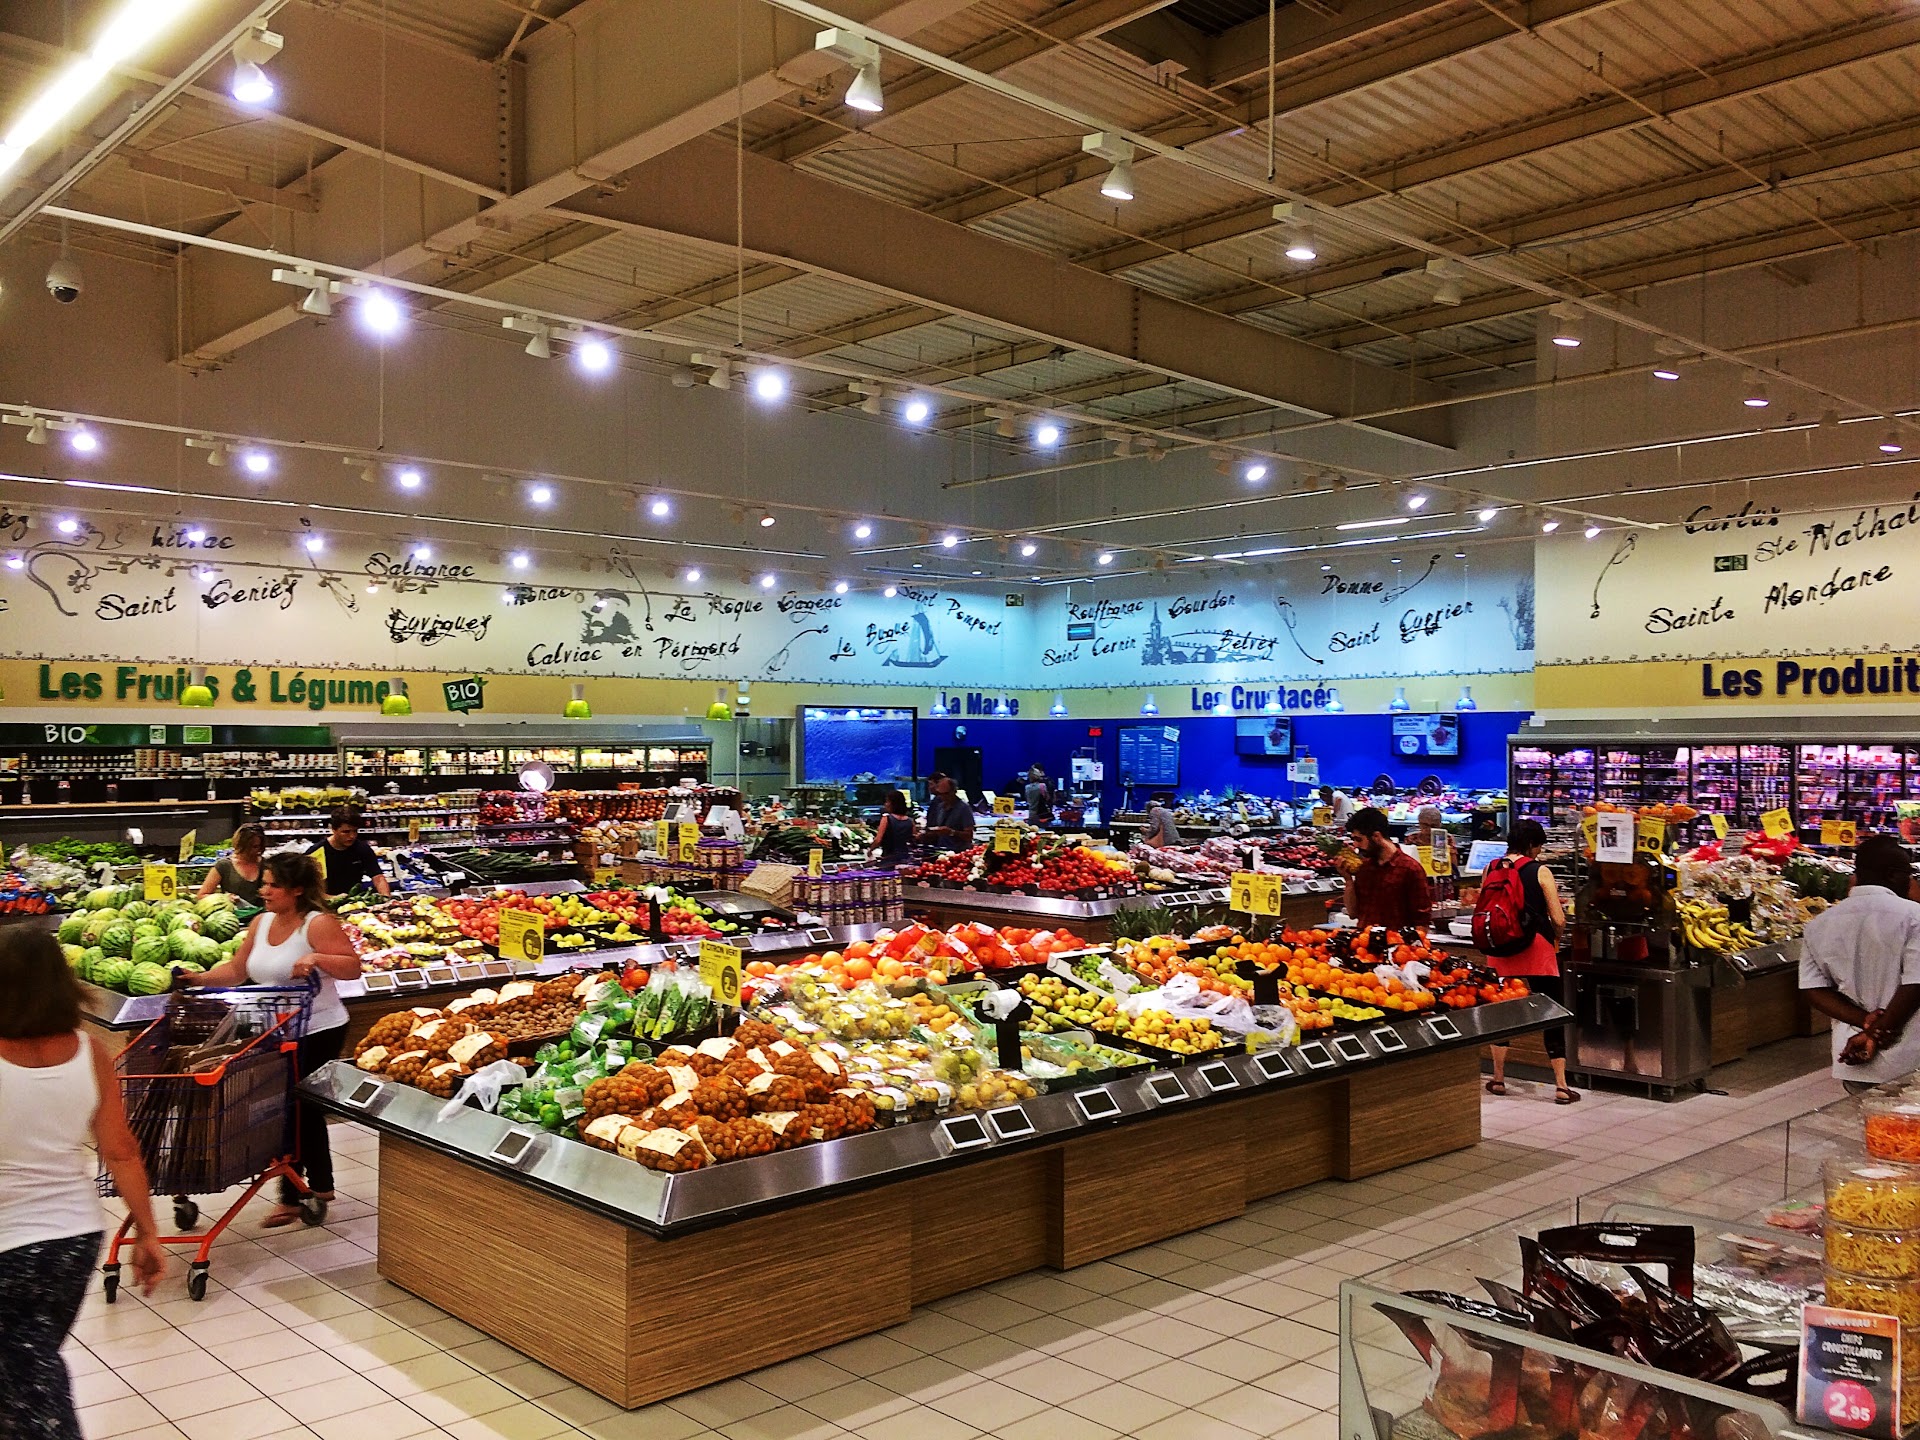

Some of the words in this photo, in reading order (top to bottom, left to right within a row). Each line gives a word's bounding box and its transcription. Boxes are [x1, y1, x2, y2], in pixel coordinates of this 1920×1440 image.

[1754, 536, 1799, 563] Ste
[365, 553, 475, 591] Salignac
[1321, 575, 1384, 595] Domme
[96, 588, 176, 621] Saint
[1168, 590, 1236, 619] Gourdon
[1645, 596, 1736, 634] Sainte
[830, 637, 857, 662] Le
[1329, 622, 1380, 653] Saint
[527, 642, 603, 668] Calviac
[622, 644, 643, 658] en
[1041, 643, 1080, 667] Saint
[39, 664, 103, 700] Les
[117, 666, 219, 700] Fruis
[232, 669, 257, 702] &
[1702, 664, 1763, 697] Les
[1776, 656, 1920, 697] Produit
[447, 683, 480, 701] BIO
[44, 724, 87, 744] BIO
